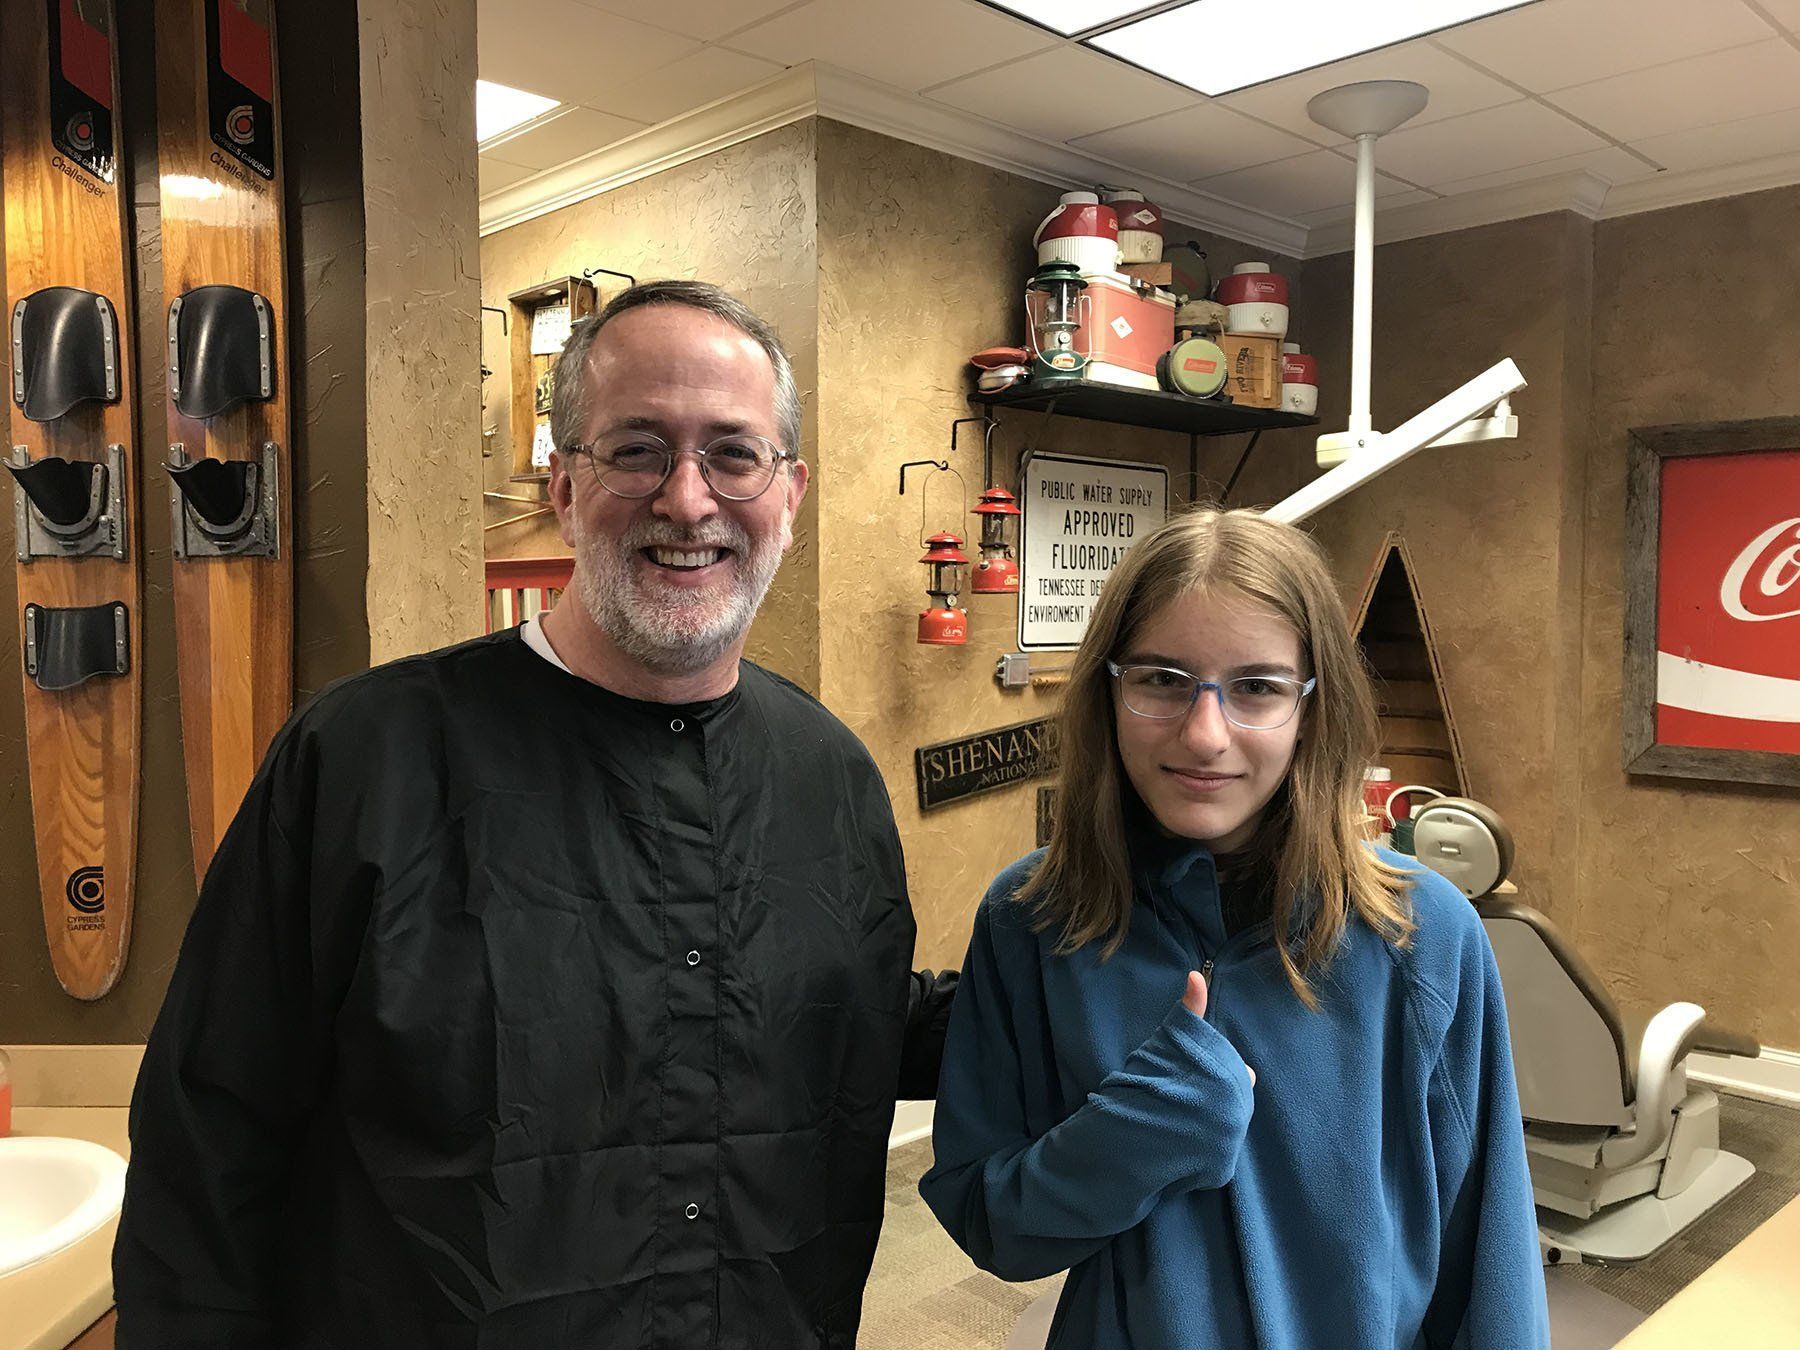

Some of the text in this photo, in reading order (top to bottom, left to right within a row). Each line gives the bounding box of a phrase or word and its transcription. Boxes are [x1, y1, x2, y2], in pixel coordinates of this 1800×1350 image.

[51, 156, 106, 198] Challenger
[1041, 480, 1153, 507] PUBLIC WATER SUPPLY
[1063, 509, 1135, 538] APPROVED
[1039, 578, 1086, 597] TENNESSEE
[1028, 605, 1085, 623] ENVIRONMENT
[66, 915, 105, 924] CYPRESS
[66, 923, 105, 931] GARDENS
